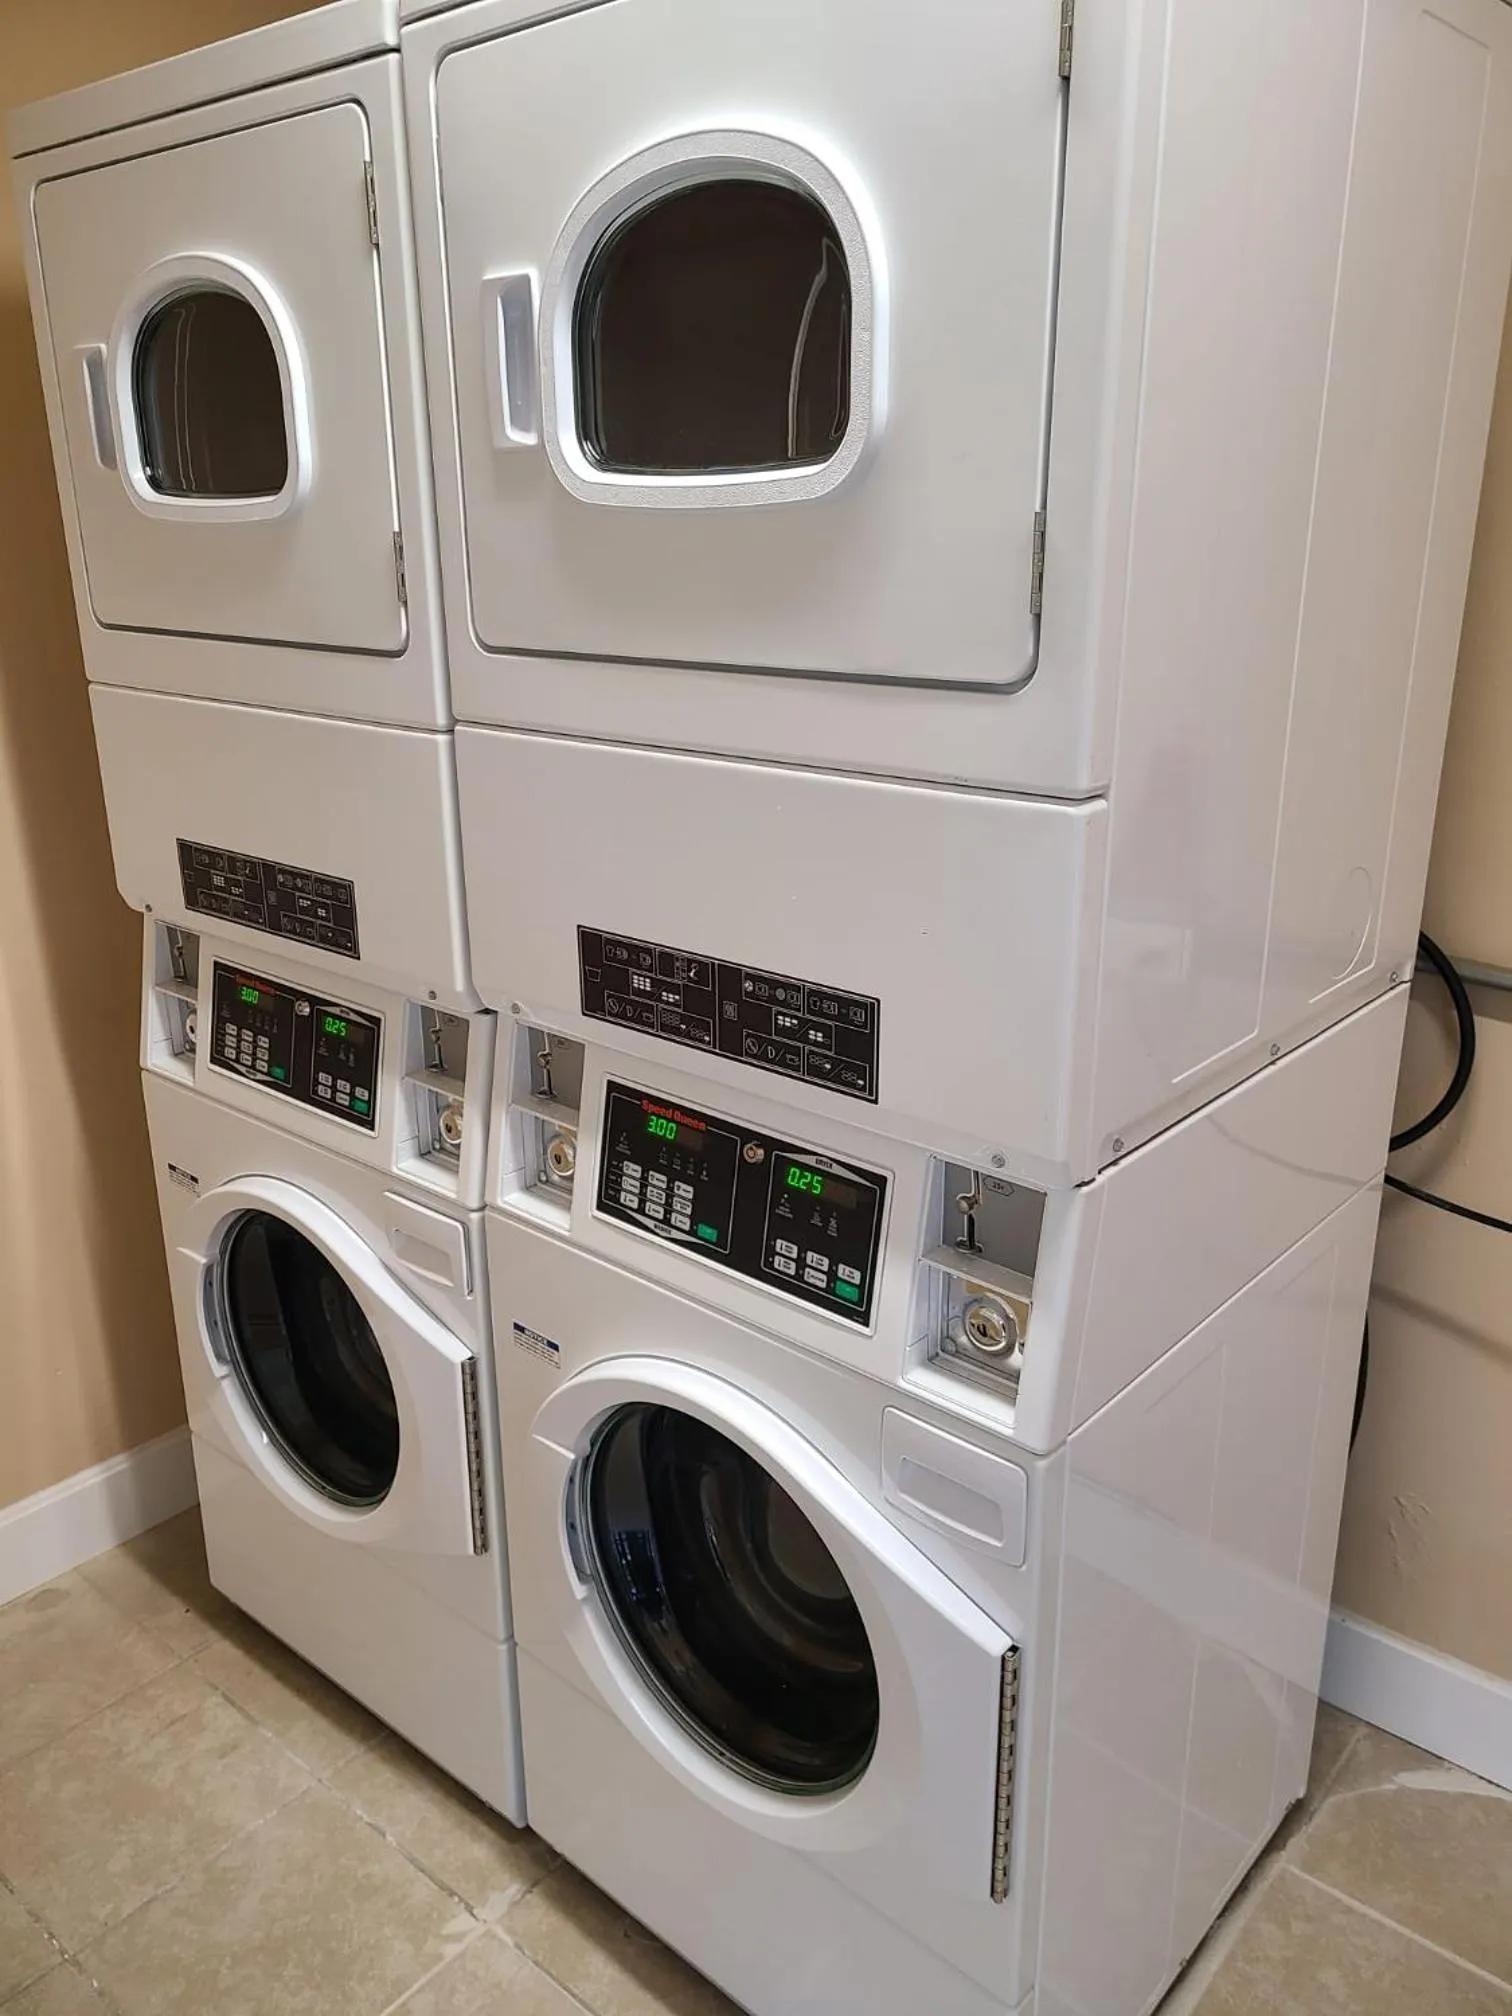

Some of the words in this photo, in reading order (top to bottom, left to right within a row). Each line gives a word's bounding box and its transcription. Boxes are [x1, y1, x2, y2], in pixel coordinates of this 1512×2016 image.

[642, 1100, 673, 1118] Speed
[674, 1110, 706, 1131] Queen
[647, 1115, 678, 1140] 3.00
[787, 1167, 823, 1195] 0.25
